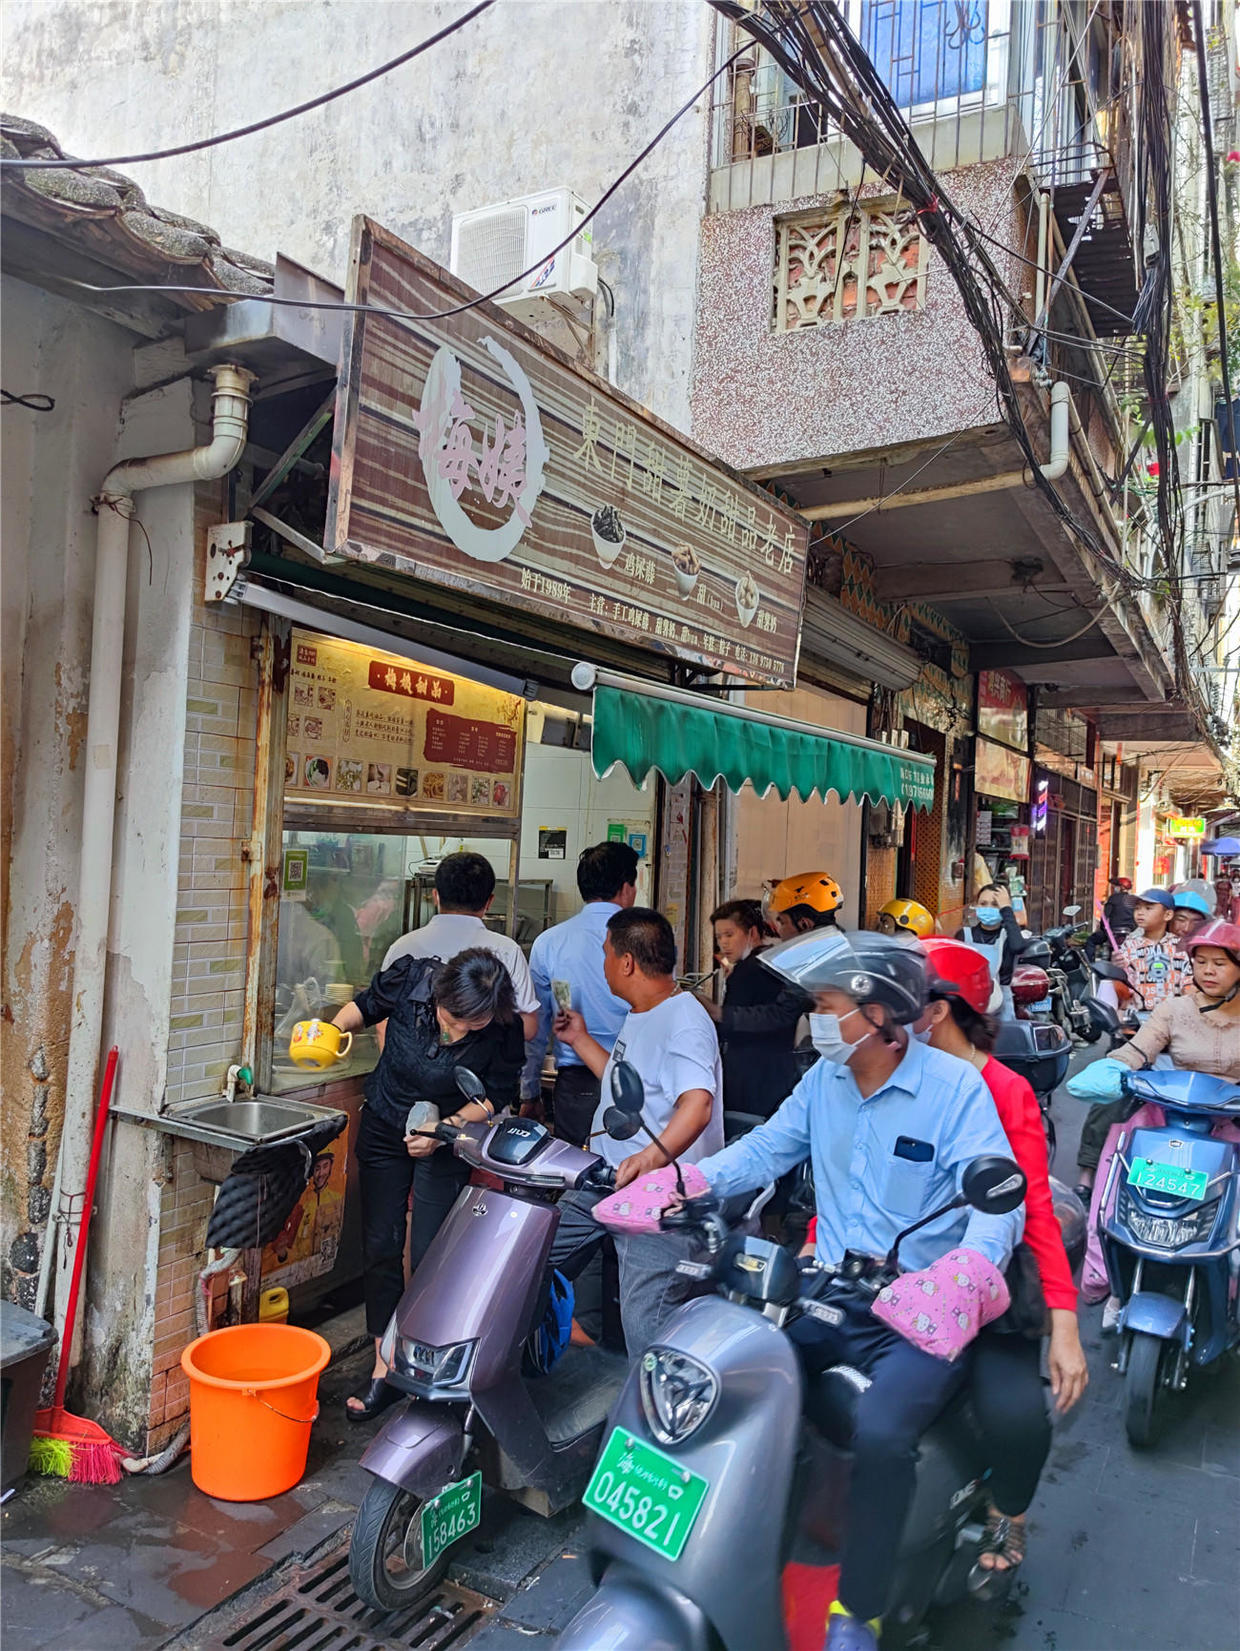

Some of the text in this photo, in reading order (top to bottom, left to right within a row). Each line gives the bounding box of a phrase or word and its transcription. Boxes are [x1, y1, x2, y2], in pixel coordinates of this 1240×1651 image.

[521, 568, 571, 604] 始于1989年
[1137, 1171, 1201, 1197] 124547
[428, 1502, 476, 1559] 158463
[594, 1471, 681, 1546] 045821
